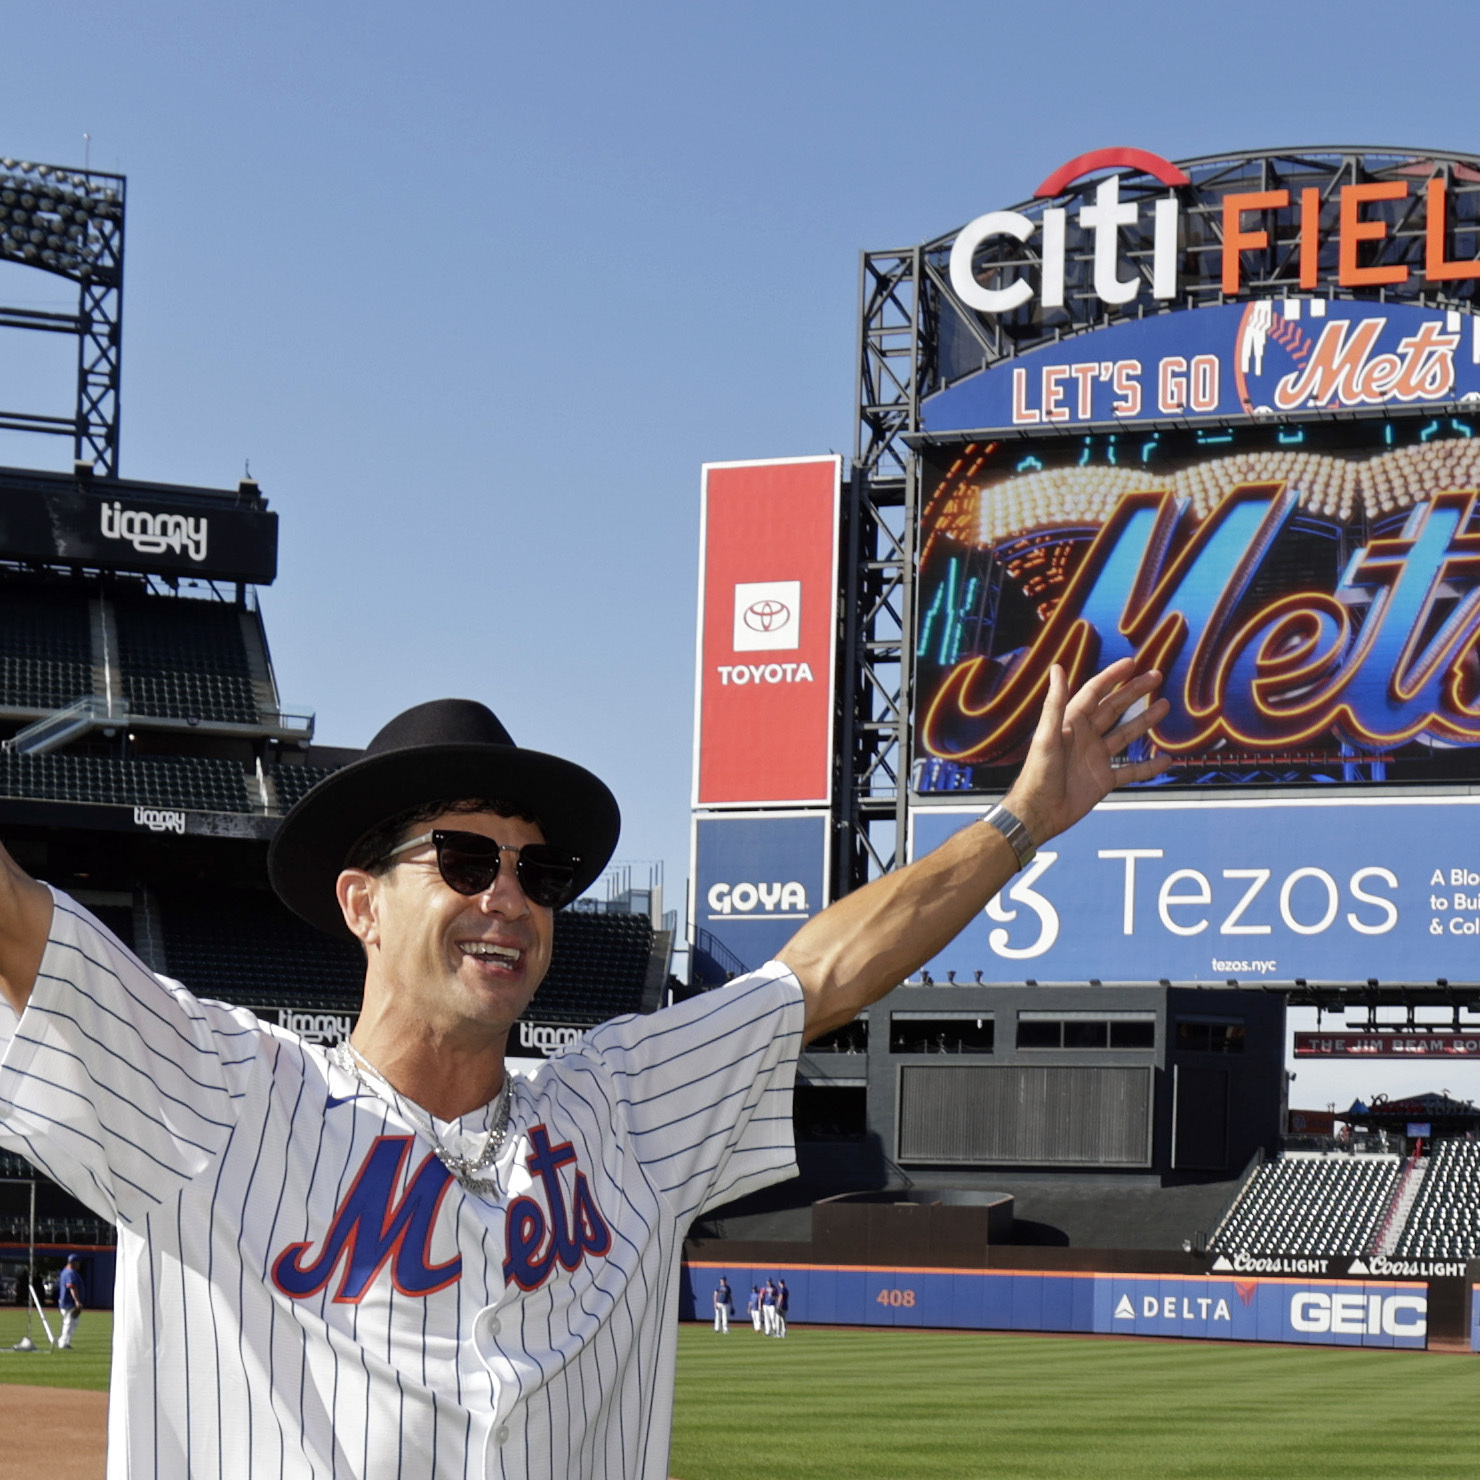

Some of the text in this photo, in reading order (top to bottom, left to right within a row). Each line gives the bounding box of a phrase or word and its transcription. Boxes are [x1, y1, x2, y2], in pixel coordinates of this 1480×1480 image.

[949, 174, 1178, 313] citi
[1274, 316, 1461, 411] Mets
[1012, 354, 1221, 424] LET'S GO
[717, 661, 814, 686] TOYOTA
[1430, 869, 1446, 886] A
[707, 881, 809, 914] GOYA
[1097, 848, 1400, 937] Tezos
[1429, 895, 1448, 911] to
[1429, 919, 1445, 935] &
[1211, 957, 1278, 974] tezos.nyc
[1308, 1038, 1346, 1051] THE
[1354, 1038, 1384, 1051] JIM
[1391, 1038, 1444, 1052] BEAM
[270, 1122, 612, 1305] Mets
[1233, 1251, 1329, 1274] Coors LIGHT
[1370, 1255, 1467, 1277] Coors LIGHT
[876, 1288, 916, 1308] 408
[1143, 1295, 1231, 1321] DELTA
